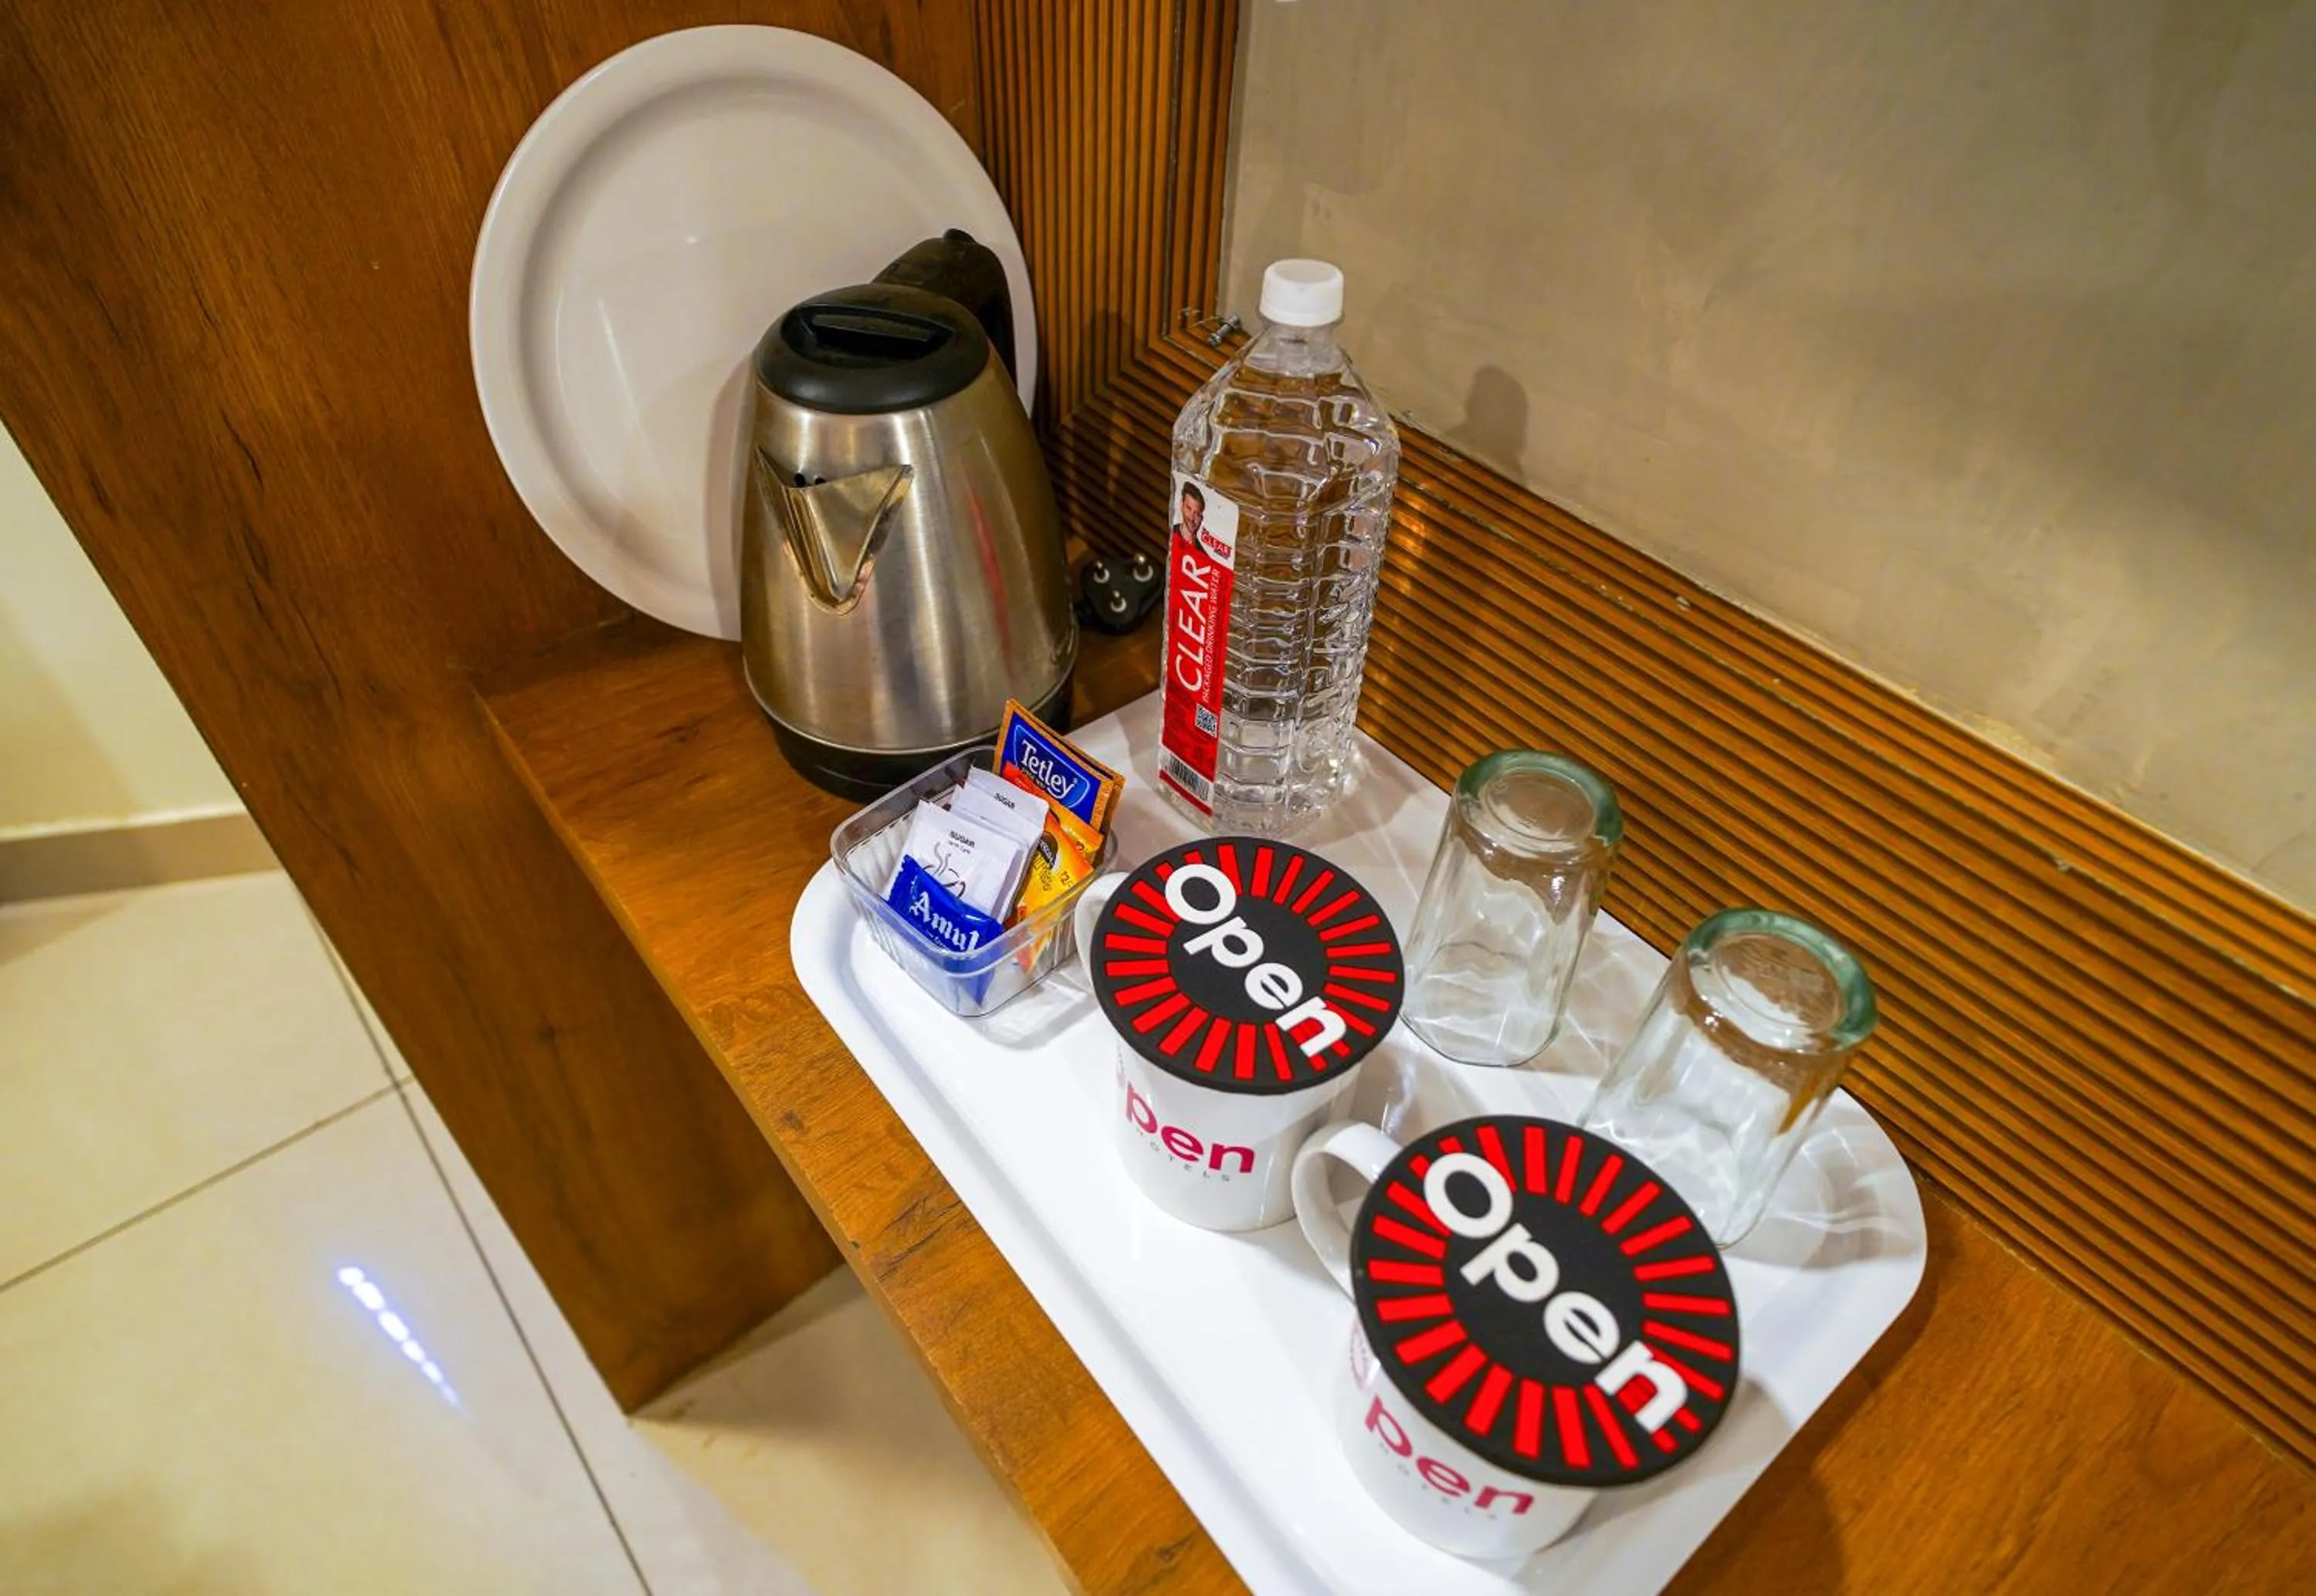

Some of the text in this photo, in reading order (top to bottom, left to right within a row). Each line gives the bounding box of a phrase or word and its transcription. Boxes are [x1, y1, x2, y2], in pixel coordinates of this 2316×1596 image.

[1175, 554, 1210, 692] CLEAR
[1202, 568, 1221, 703] PACKAGED DRINKING WATER
[994, 792, 1016, 810] SUGAR
[1021, 739, 1075, 799] Tetley
[950, 830, 975, 848] SUGAR
[909, 891, 980, 955] Amul
[1164, 863, 1347, 1058] Open
[1424, 1151, 1688, 1434] Open
